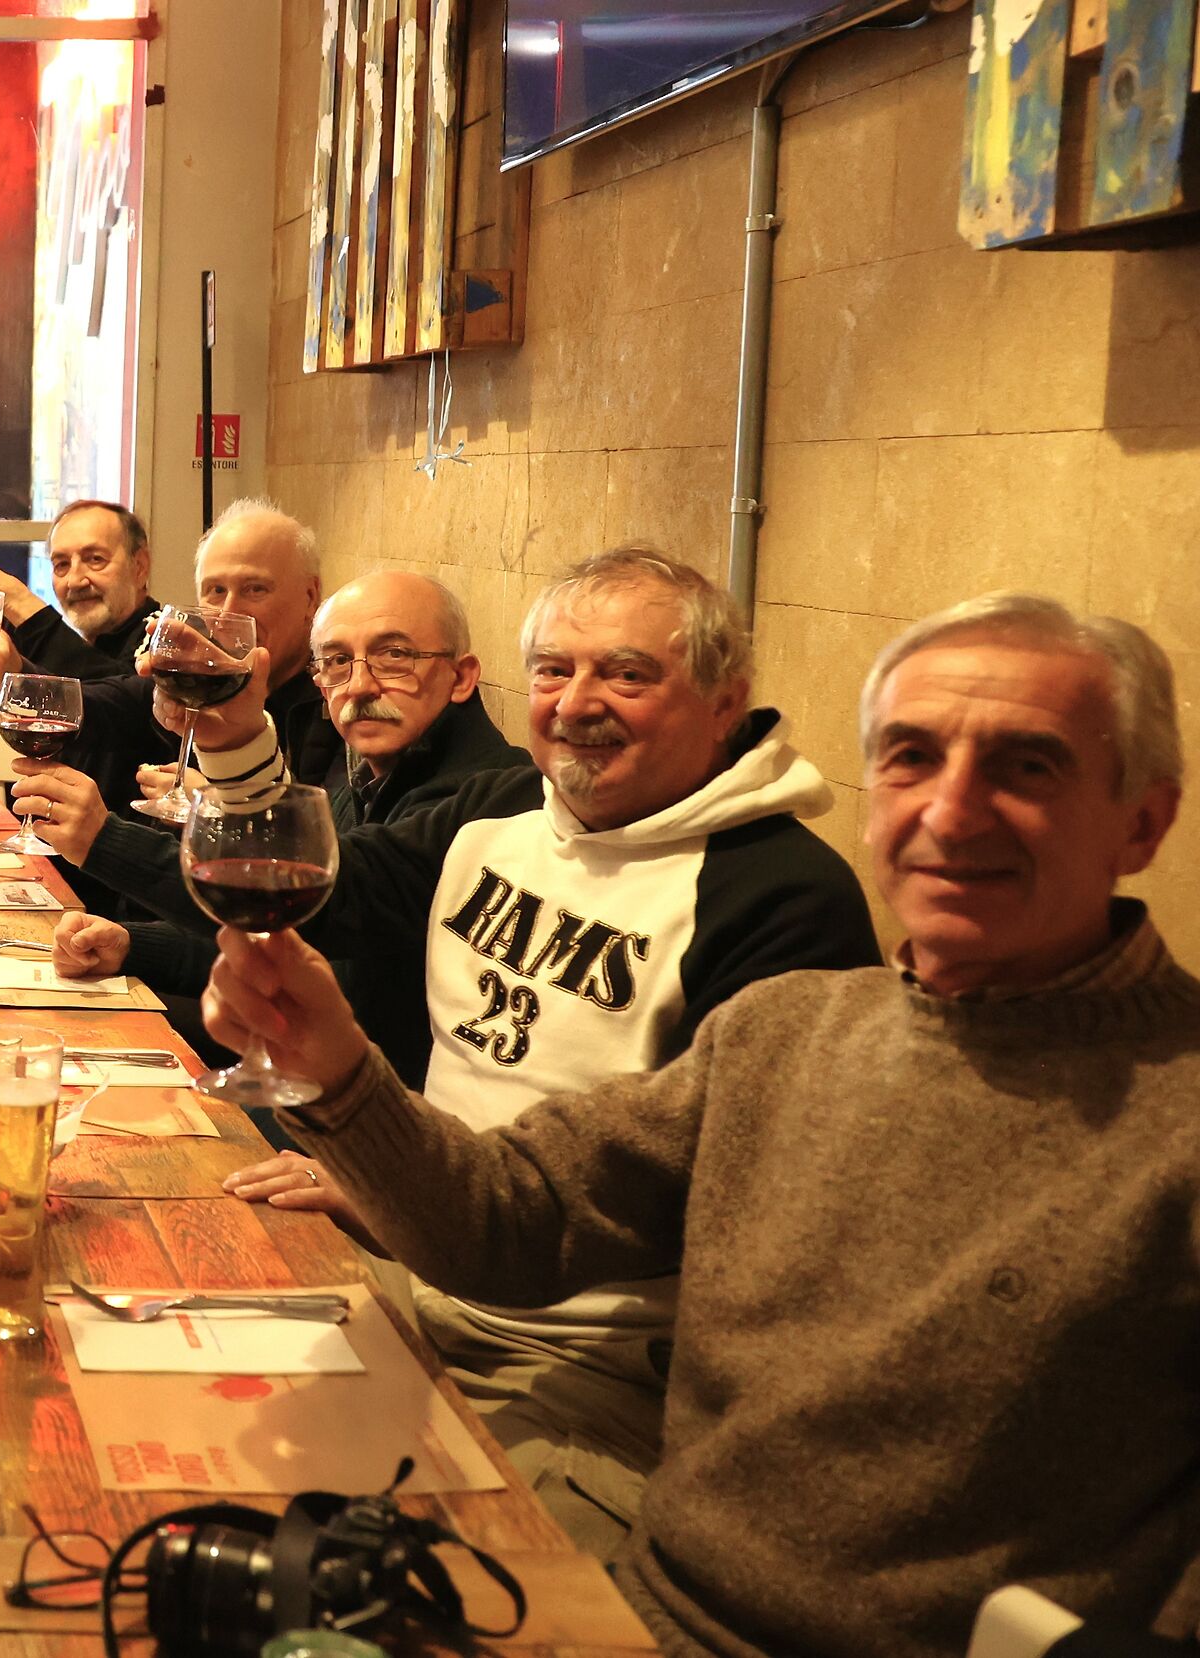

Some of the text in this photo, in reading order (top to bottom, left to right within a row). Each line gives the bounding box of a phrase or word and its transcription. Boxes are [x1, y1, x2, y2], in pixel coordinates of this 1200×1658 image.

[191, 460, 240, 470] ESNTORE
[440, 866, 652, 1012] RAMS
[451, 969, 541, 1067] 23
